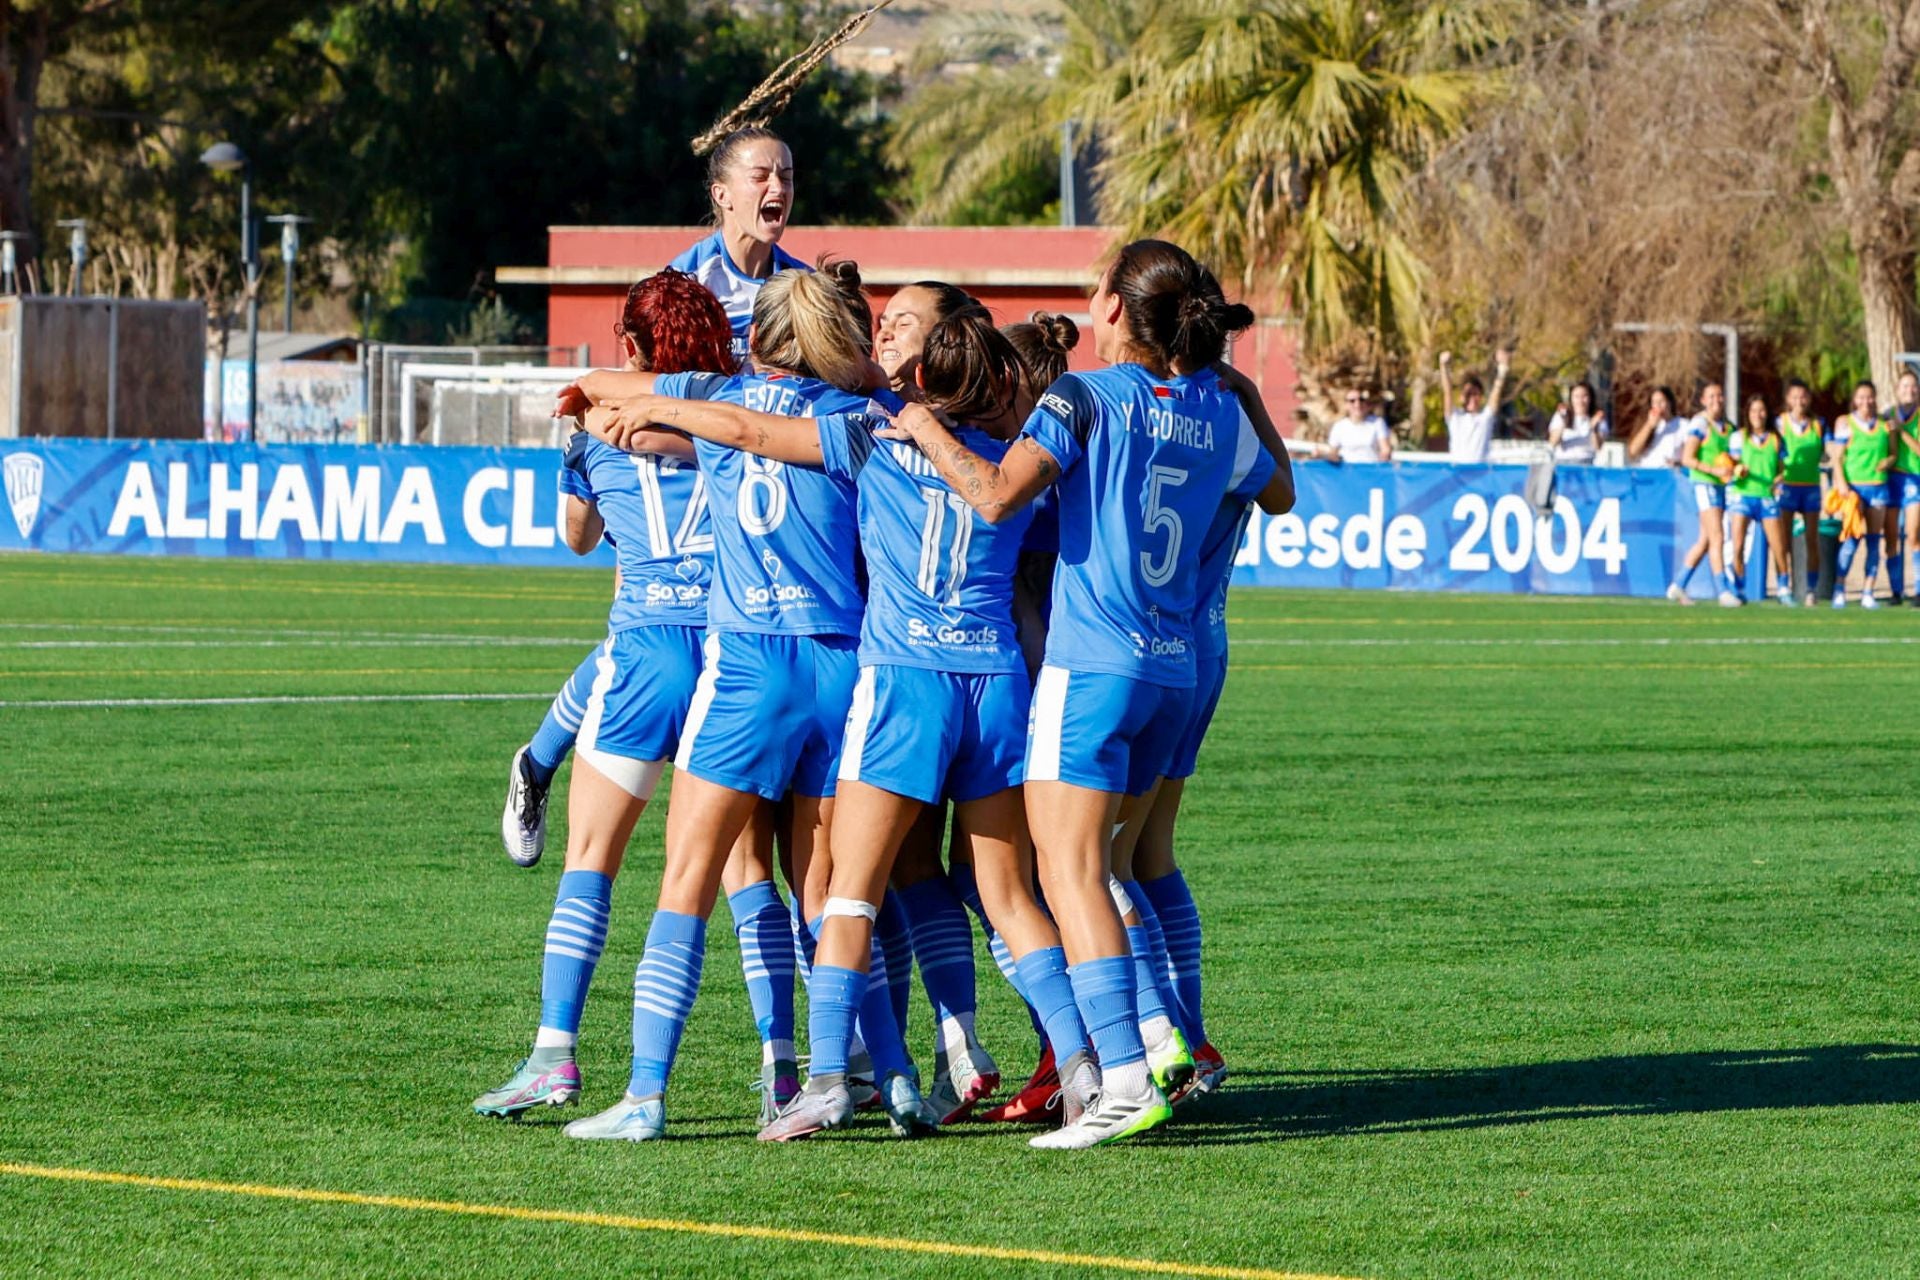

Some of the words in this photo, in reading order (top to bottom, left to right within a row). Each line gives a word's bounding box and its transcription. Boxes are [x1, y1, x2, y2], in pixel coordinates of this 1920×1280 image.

[1121, 401, 1138, 434] Y.
[1147, 407, 1214, 451] CORREA
[107, 461, 446, 545] ALHAMA
[737, 451, 787, 536] 8
[1140, 464, 1189, 588] 5
[1449, 493, 1628, 575] 2004
[917, 487, 973, 607] 11
[646, 582, 673, 601] So
[745, 581, 769, 605] So
[936, 625, 998, 644] Goods
